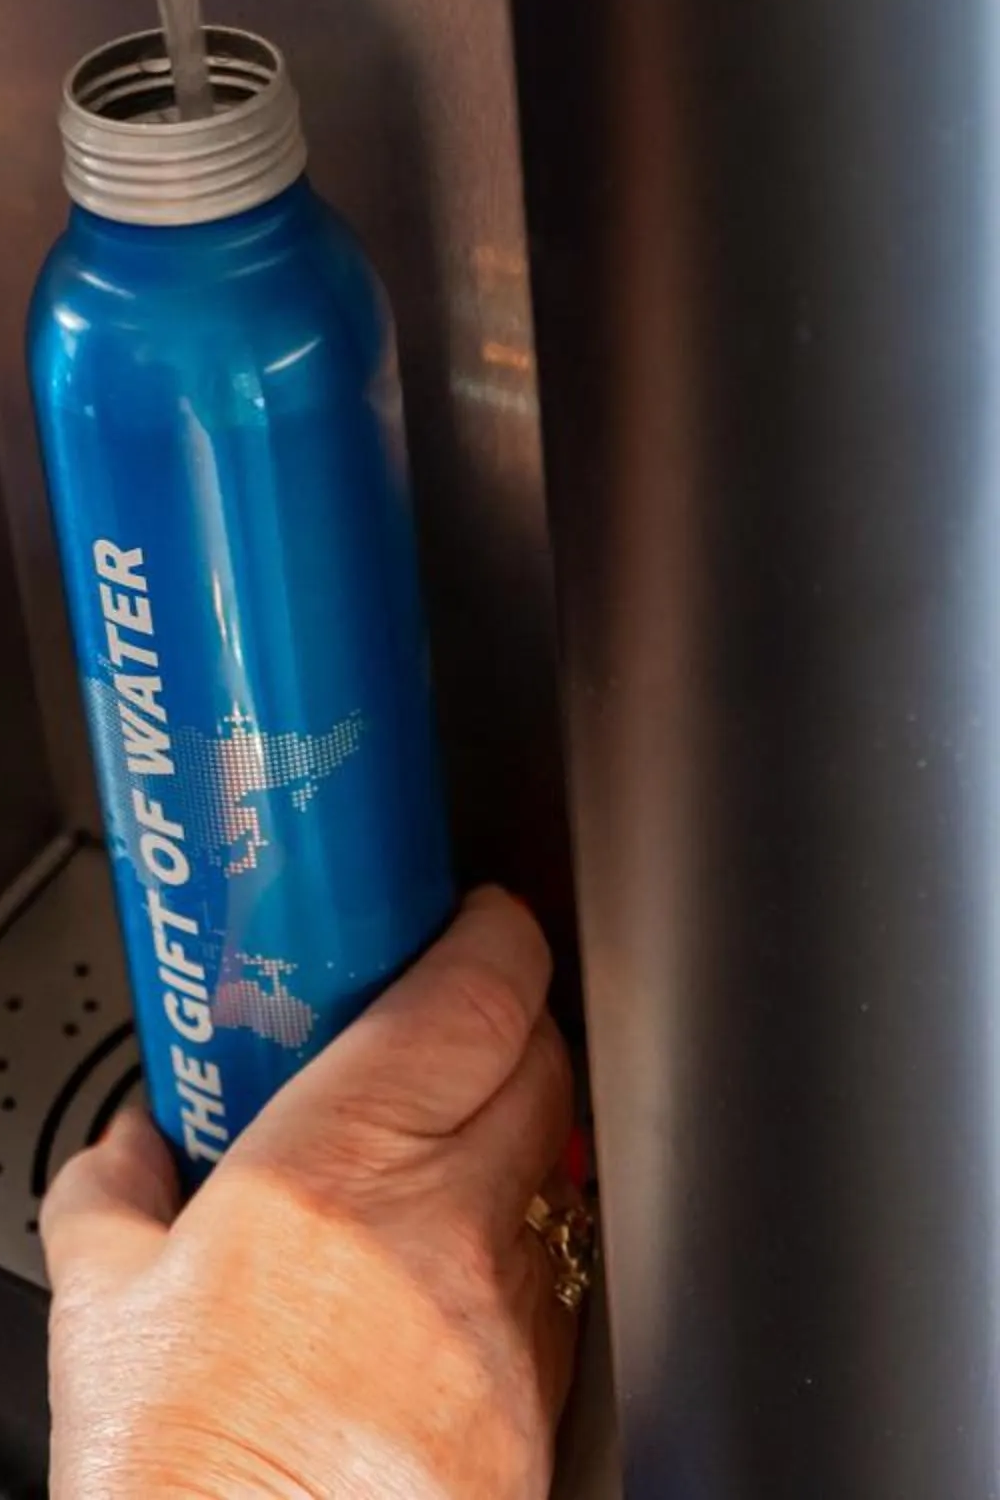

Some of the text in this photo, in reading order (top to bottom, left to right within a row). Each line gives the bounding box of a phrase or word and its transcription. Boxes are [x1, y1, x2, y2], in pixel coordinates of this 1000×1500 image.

[93, 538, 229, 1163] THE GIFT OF WATER
